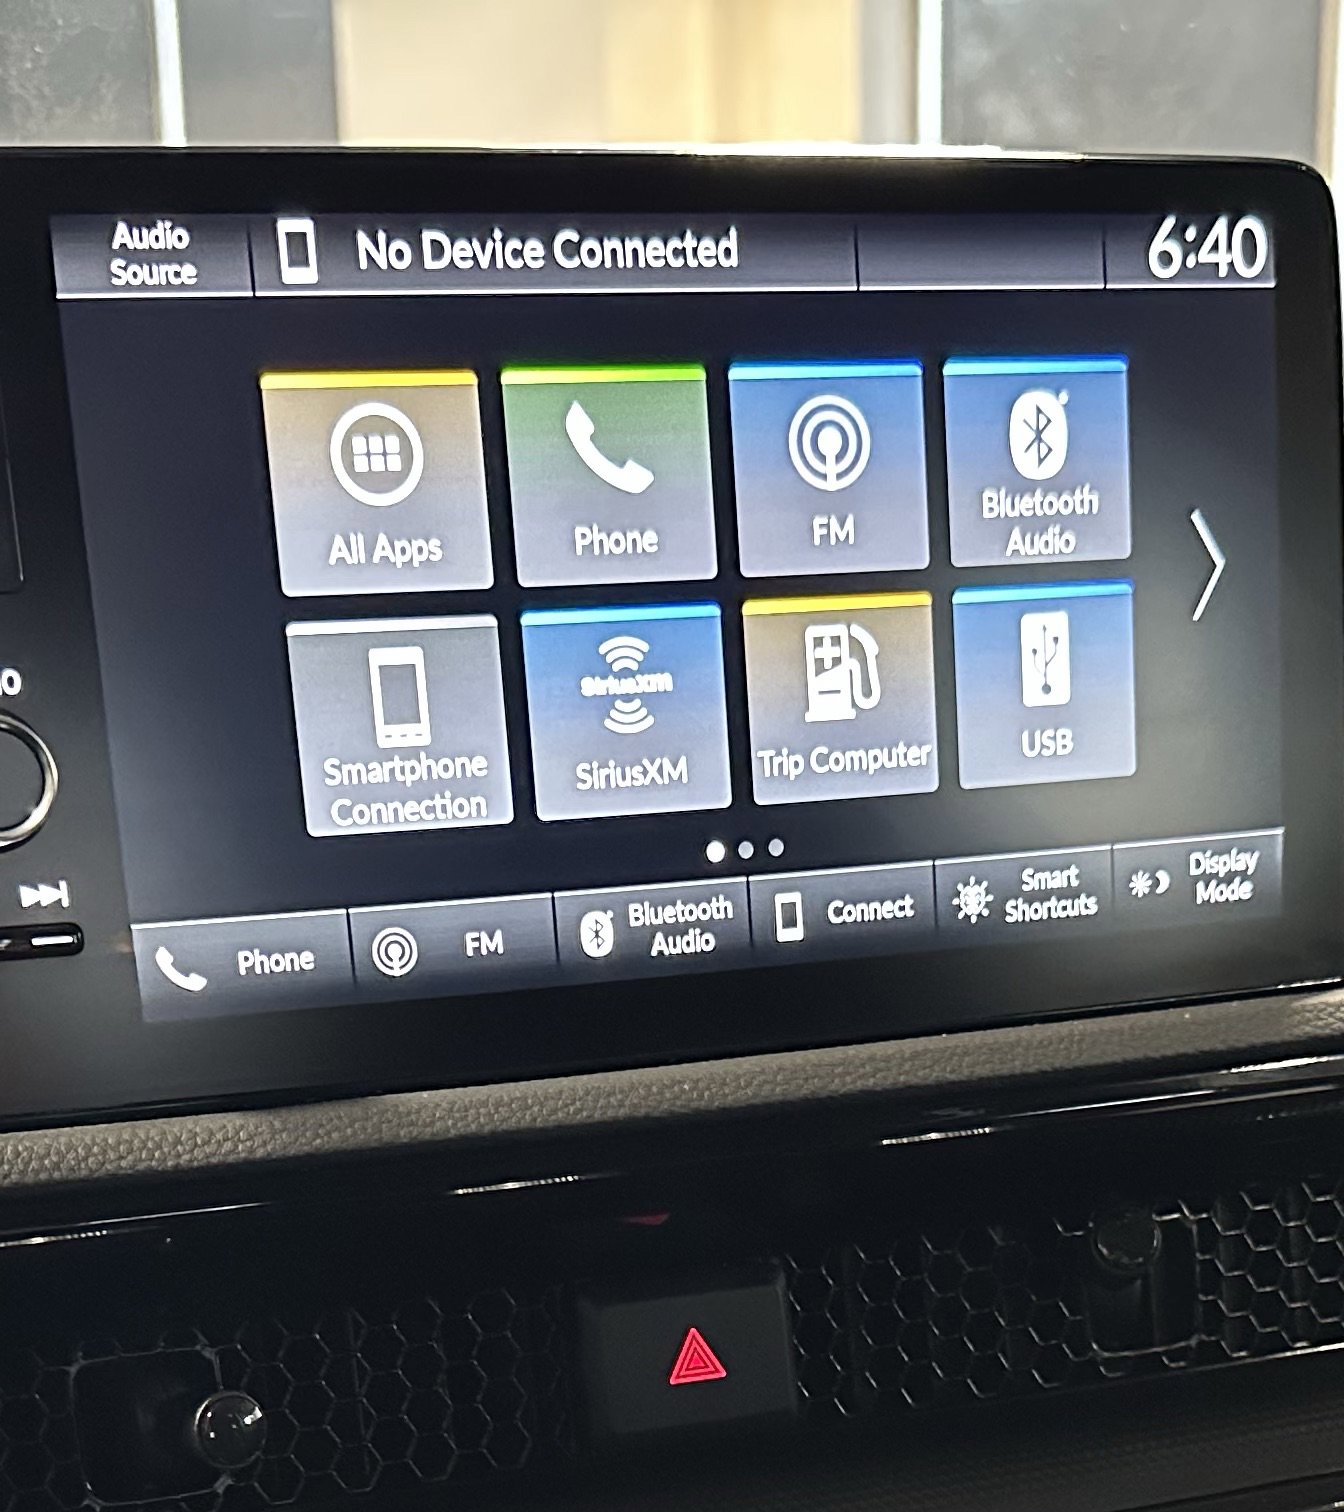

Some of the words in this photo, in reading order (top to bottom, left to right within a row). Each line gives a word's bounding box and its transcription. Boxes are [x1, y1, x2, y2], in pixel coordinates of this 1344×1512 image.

[111, 219, 191, 250] Audio
[356, 229, 413, 270] No
[421, 227, 545, 270] Device
[553, 225, 739, 269] Connected
[1148, 215, 1269, 279] 6:40
[110, 257, 198, 286] Source
[982, 486, 1099, 519] Bluetooth
[574, 522, 659, 556] Phone
[812, 514, 855, 546] FM
[1005, 524, 1078, 560] Audio
[328, 531, 366, 566] All
[372, 532, 443, 569] Apps
[1021, 727, 1074, 758] USB
[323, 751, 489, 788] Smartphone
[575, 754, 689, 791] SiriusXM
[756, 746, 805, 781] Trip
[809, 739, 934, 781] Computer
[330, 792, 488, 829] Connection
[1021, 863, 1080, 892] Smart
[1189, 846, 1261, 880] Display
[1194, 872, 1254, 905] Mode
[628, 893, 734, 931] Bluetooth
[827, 893, 915, 924] Connect
[1004, 892, 1099, 923] Shortcuts
[465, 928, 504, 957] FM
[651, 927, 716, 957] Audio
[237, 948, 315, 976] Phone
